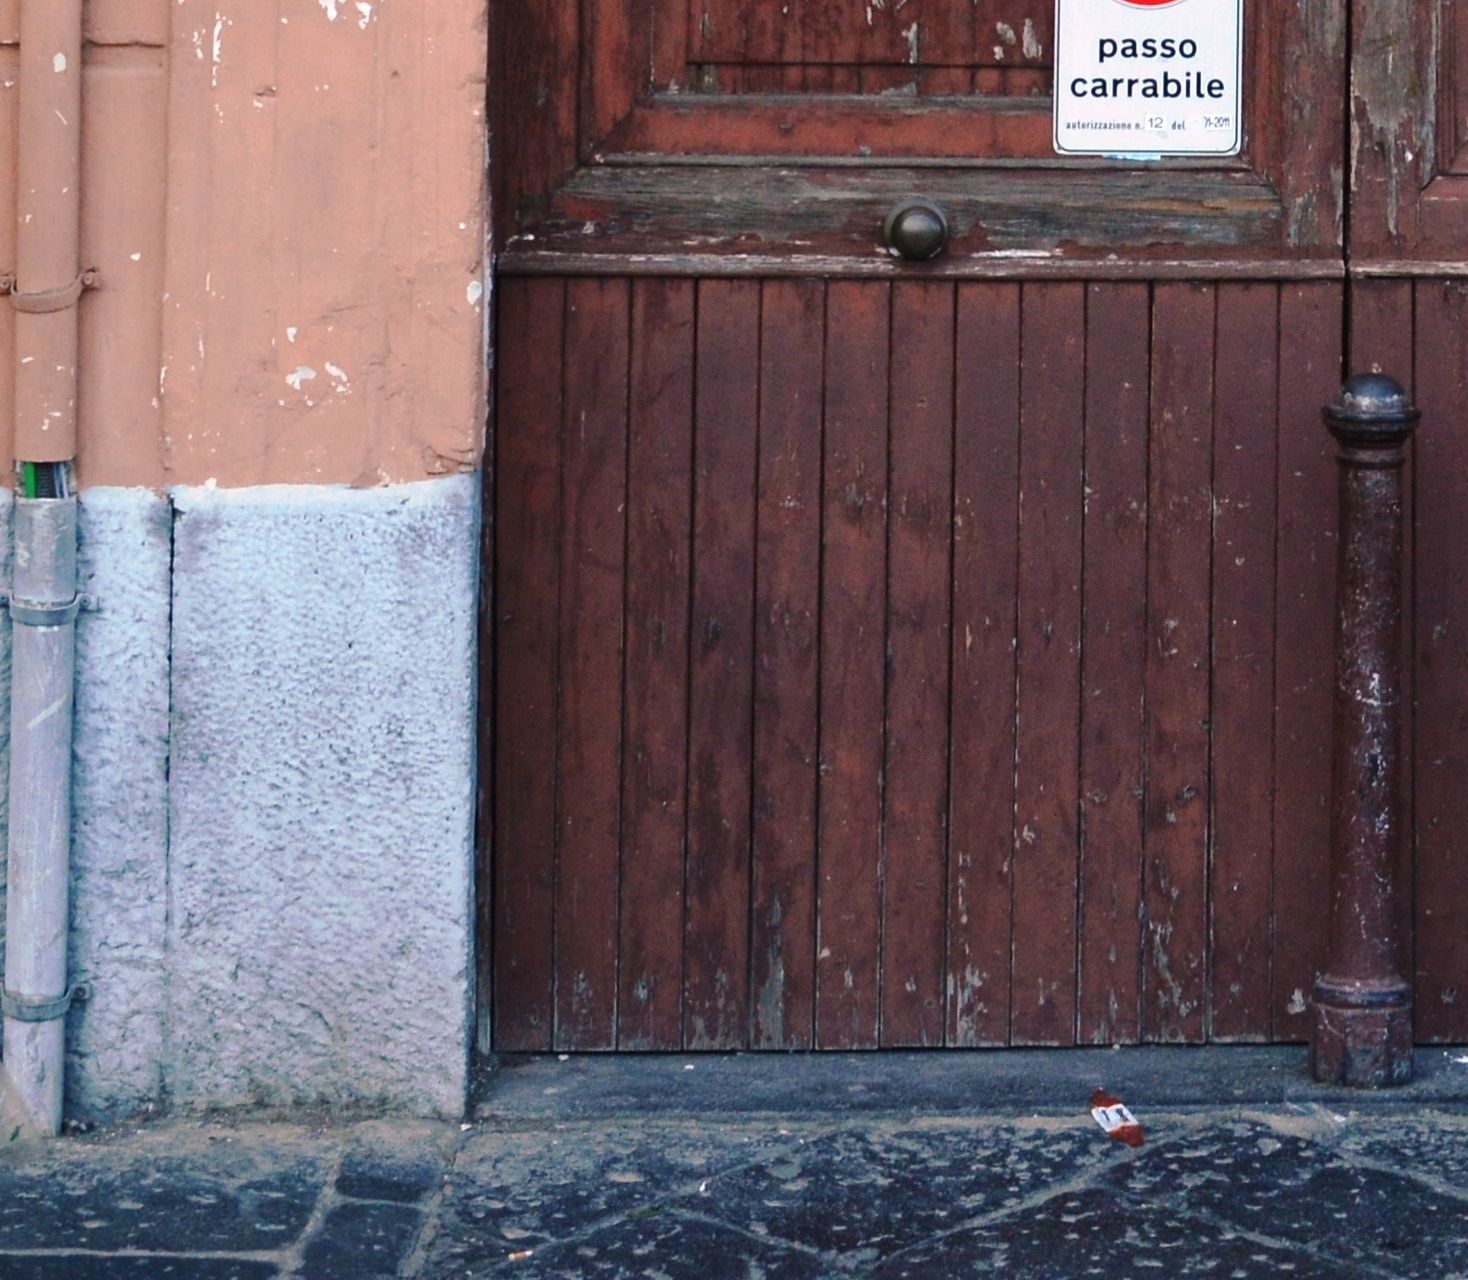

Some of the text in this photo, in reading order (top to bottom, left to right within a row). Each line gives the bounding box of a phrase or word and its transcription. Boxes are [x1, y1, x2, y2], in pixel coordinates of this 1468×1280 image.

[1099, 38, 1197, 63] passo
[1070, 71, 1224, 98] carrabile
[1066, 120, 1132, 130] autorizzazione
[1148, 116, 1164, 129] 12
[1171, 121, 1185, 130] del
